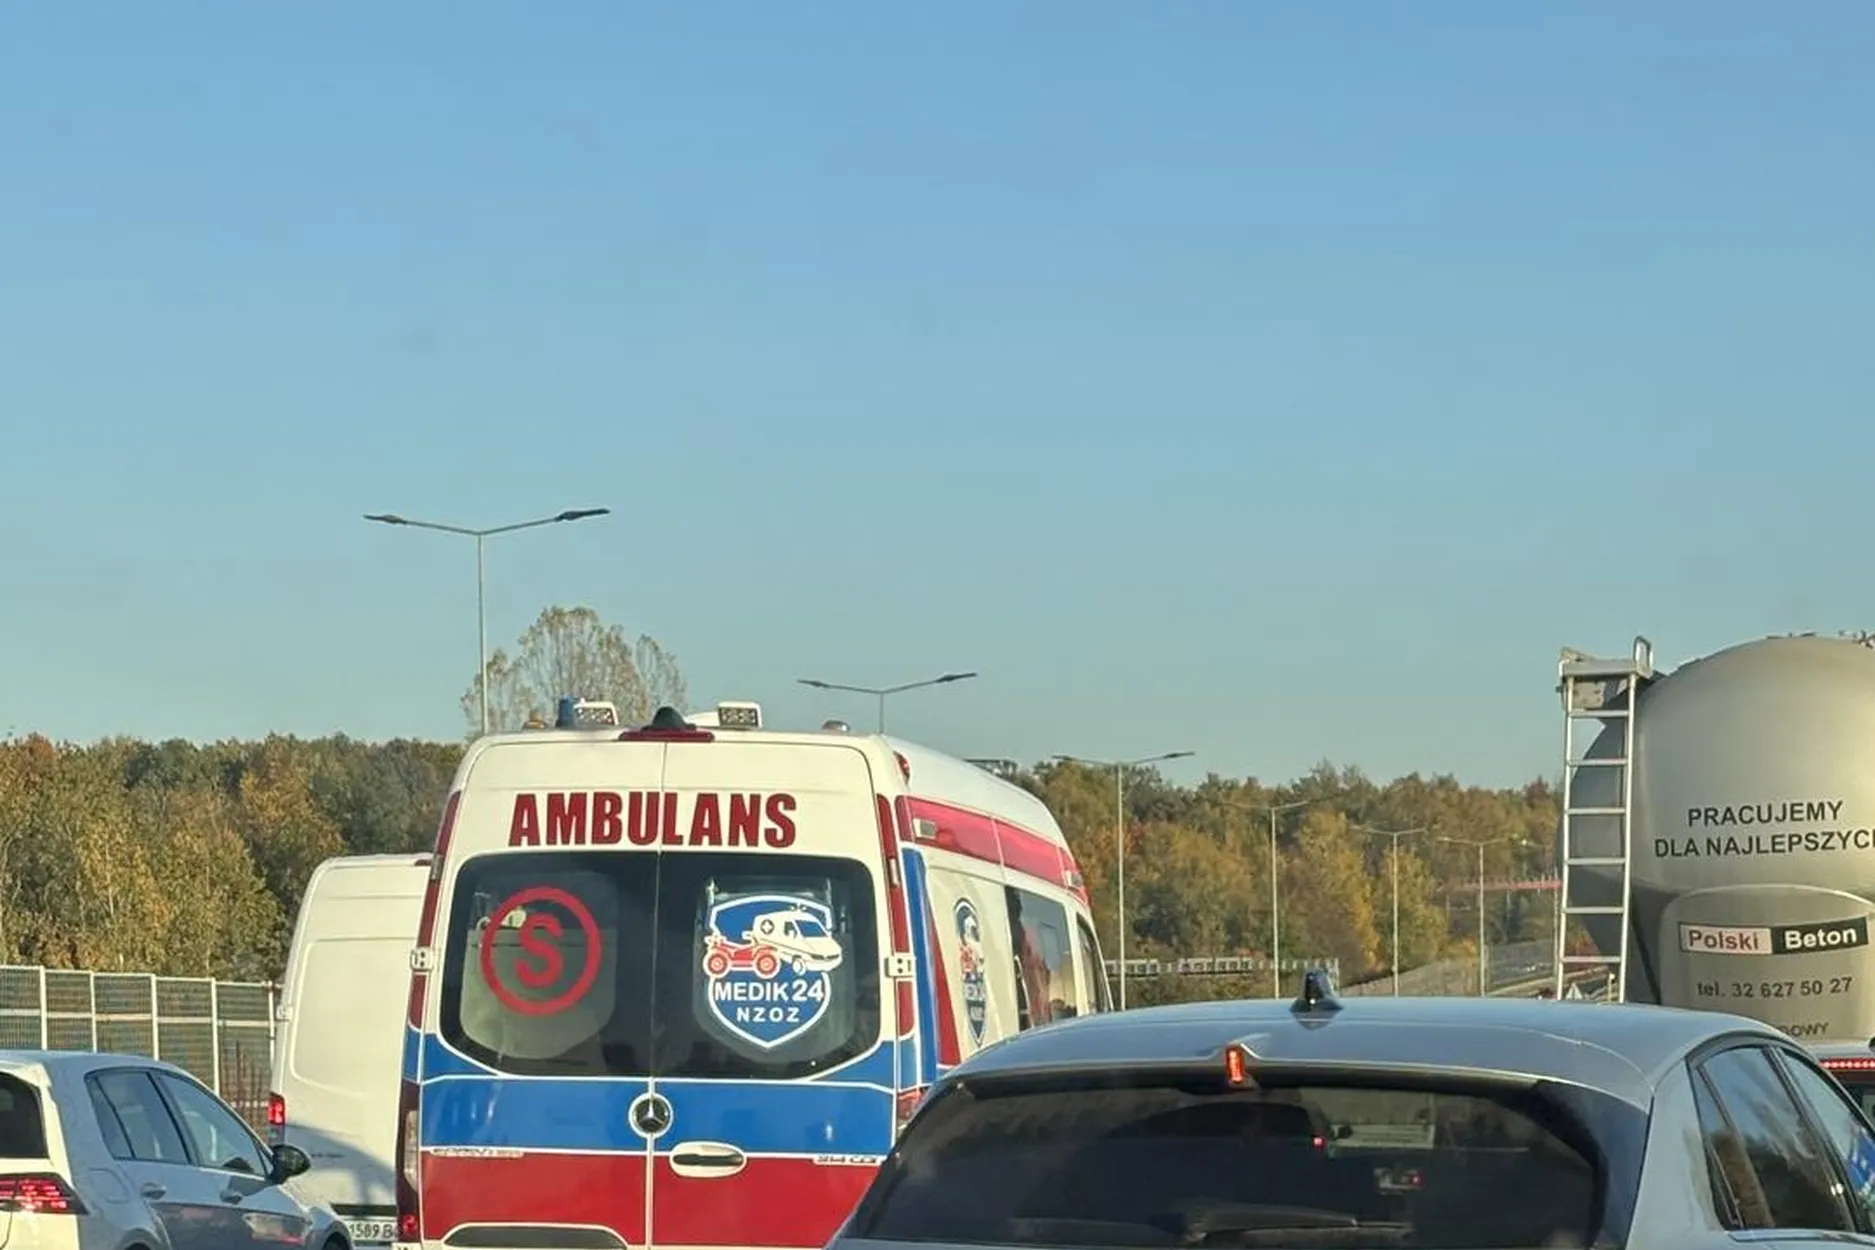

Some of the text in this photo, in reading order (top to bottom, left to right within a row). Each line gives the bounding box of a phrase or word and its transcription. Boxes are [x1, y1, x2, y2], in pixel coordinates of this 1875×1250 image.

[508, 792, 797, 848] AMBULANS
[1688, 800, 1844, 827] PRACUJEMY
[1654, 837, 1700, 858] DLA
[1689, 927, 1858, 950] Polski Beton
[514, 913, 563, 988] S
[1697, 976, 1854, 998] tel. 32 627 50 27
[735, 1006, 800, 1022] NZOZ
